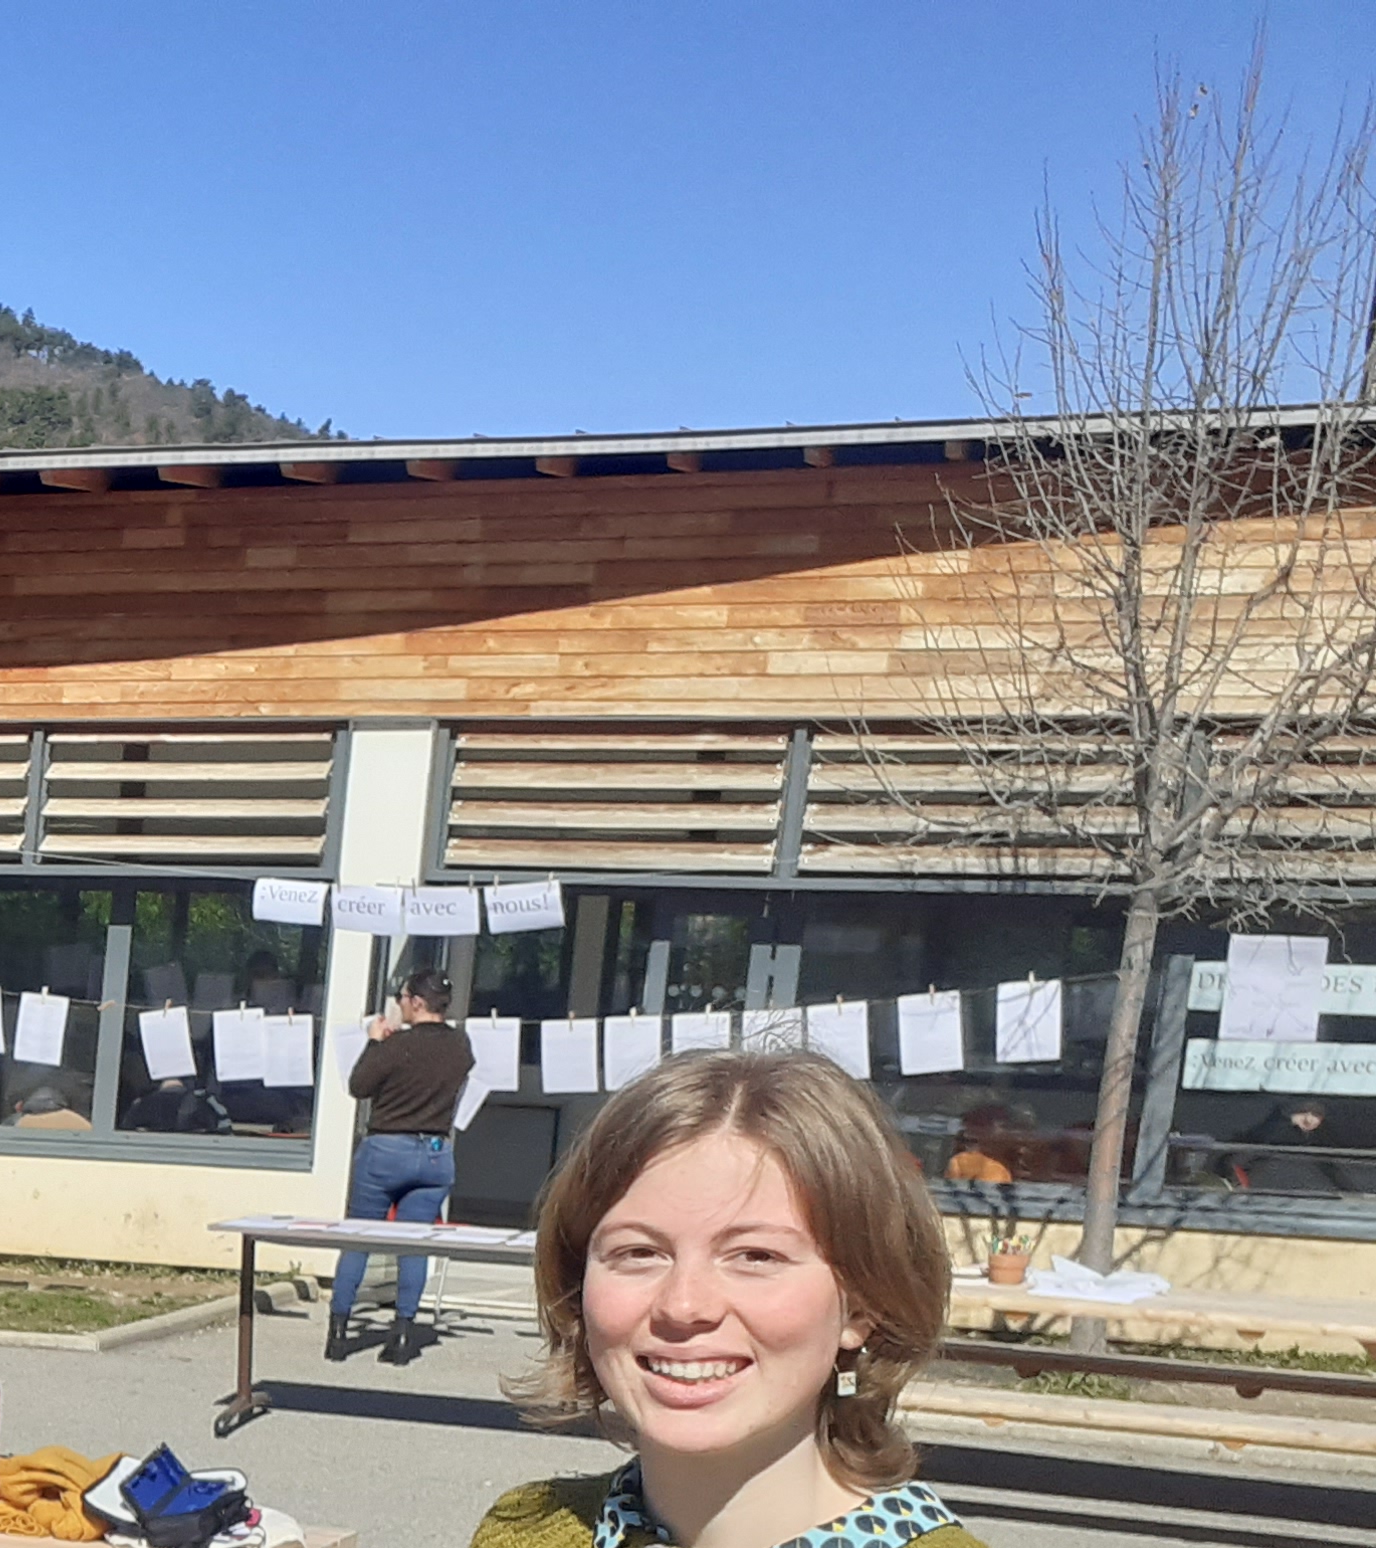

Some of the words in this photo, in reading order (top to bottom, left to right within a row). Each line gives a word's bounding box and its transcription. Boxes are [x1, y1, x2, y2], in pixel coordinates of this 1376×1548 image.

[337, 895, 386, 915] créer
[410, 901, 457, 916] avec
[491, 893, 549, 915] nous!
[1264, 1052, 1319, 1072] créer
